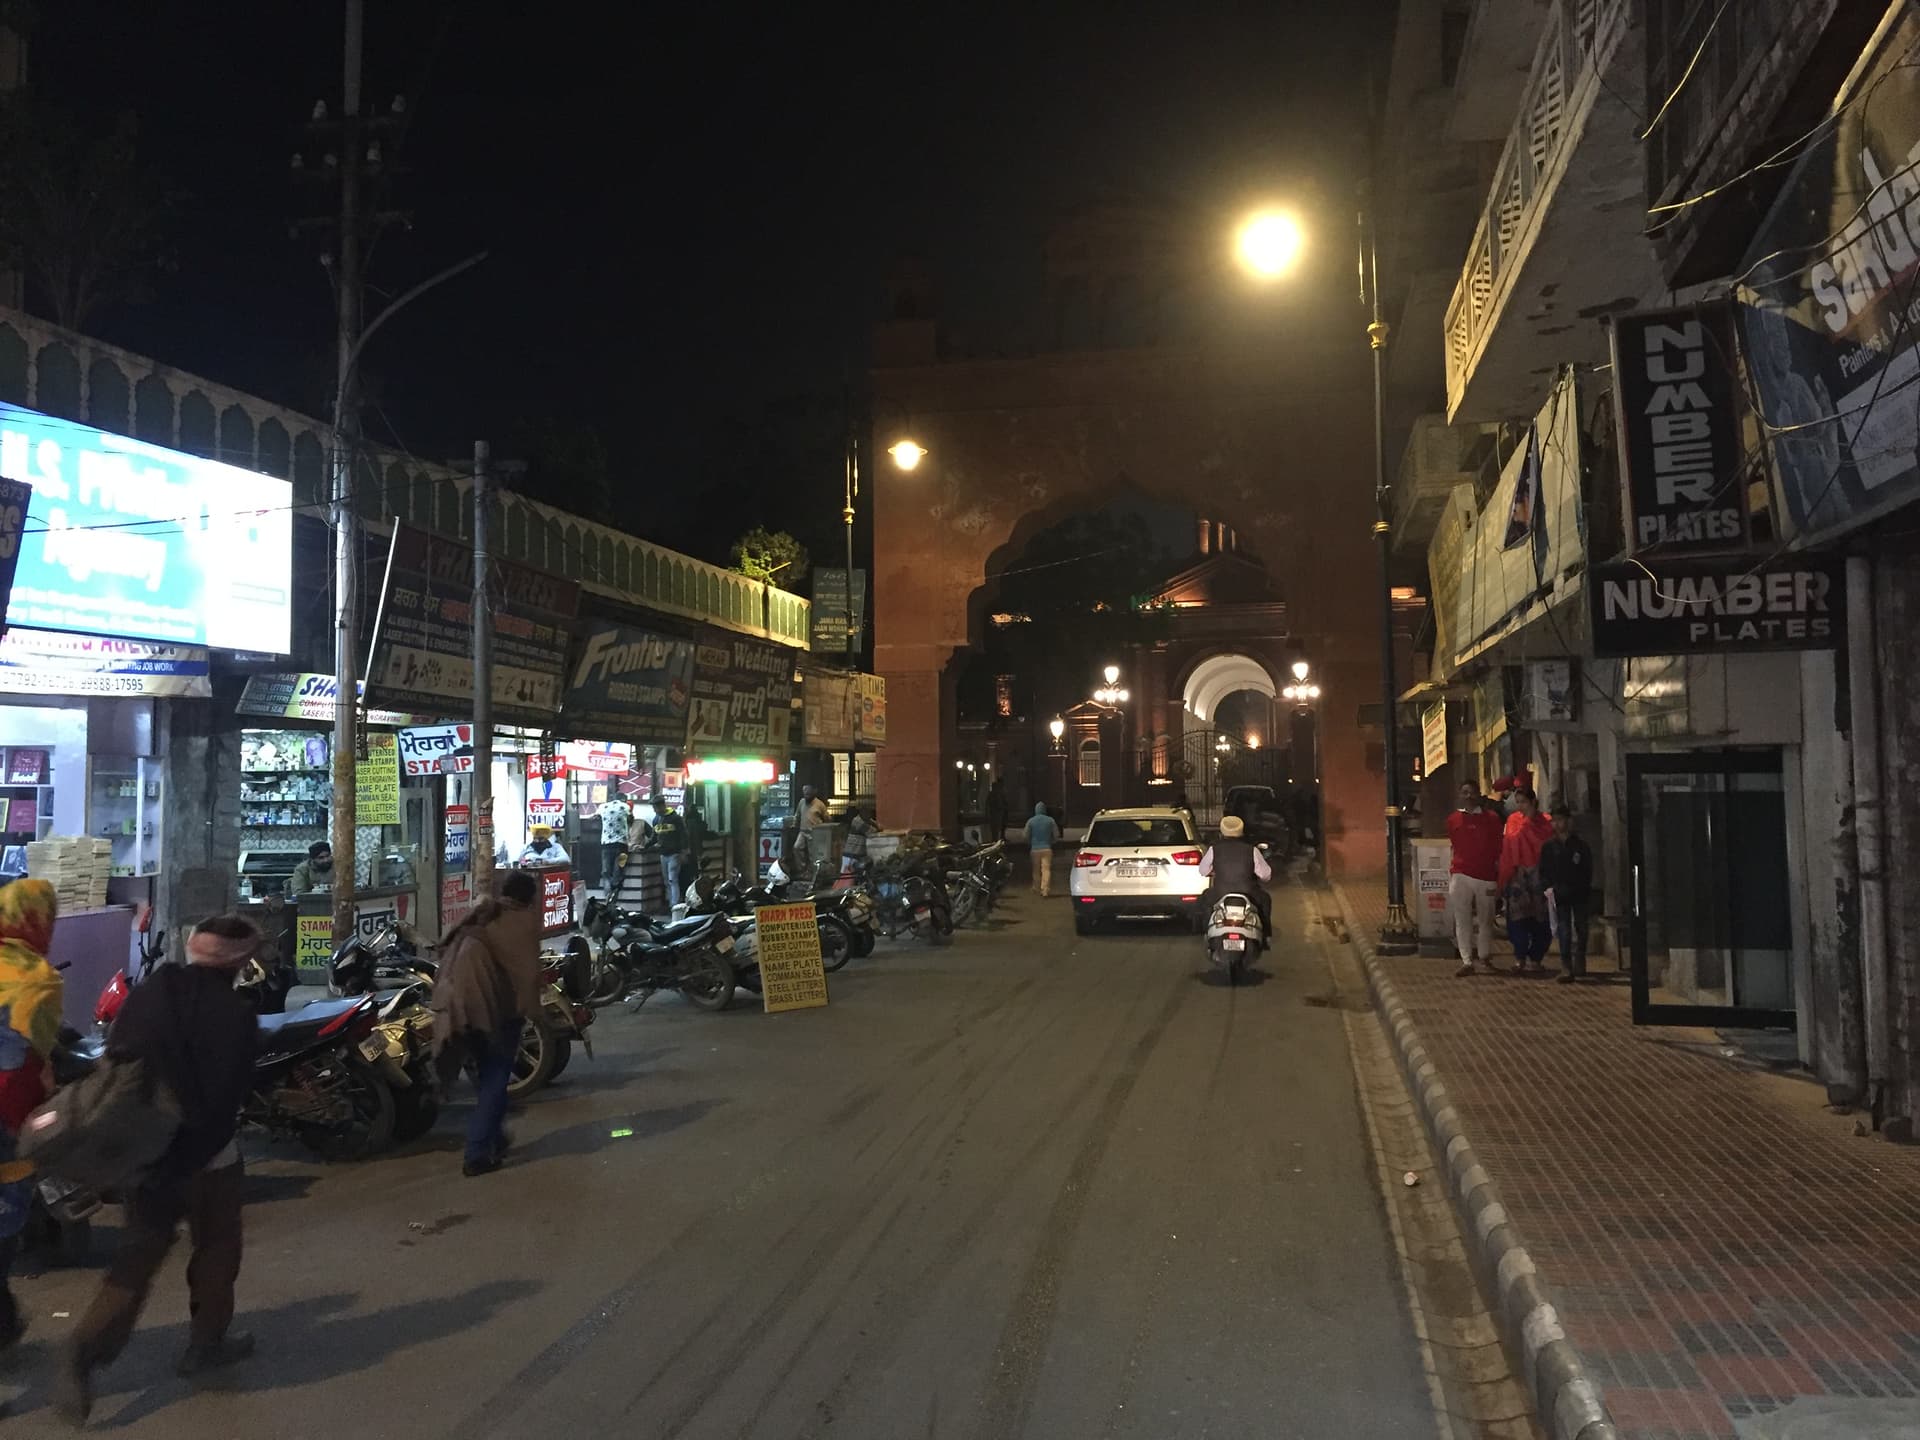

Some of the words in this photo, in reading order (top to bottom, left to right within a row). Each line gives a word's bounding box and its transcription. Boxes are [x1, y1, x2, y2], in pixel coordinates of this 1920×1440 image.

[1646, 319, 1714, 505] NUMBER
[1638, 514, 1743, 545] PLATES
[1602, 570, 1830, 621] NUMBER
[1691, 621, 1832, 643] PLATES
[154, 662, 175, 672] WORK
[733, 640, 790, 682] Wedding
[374, 784, 397, 793] PLATE
[373, 803, 397, 812] LETTERS
[374, 812, 397, 821] LETTERS
[544, 909, 569, 928] STAMPS
[789, 906, 814, 921] PRESS
[760, 921, 817, 934] COMPUTERISED
[761, 934, 790, 943] RUBBER
[791, 931, 817, 941] STAMPS
[763, 943, 788, 953] LASER
[789, 939, 819, 950] CUTTING
[764, 953, 784, 963] LASER
[785, 949, 820, 960] ENGRAVING
[765, 962, 792, 972] NAME
[793, 958, 820, 969] PLATE
[767, 971, 801, 982] COMMAN
[802, 968, 822, 978] SEAL
[768, 983, 791, 994] STEEL
[792, 979, 825, 990] LETTERS
[769, 993, 794, 1004] BRASS
[795, 990, 826, 1001] LETTERS
